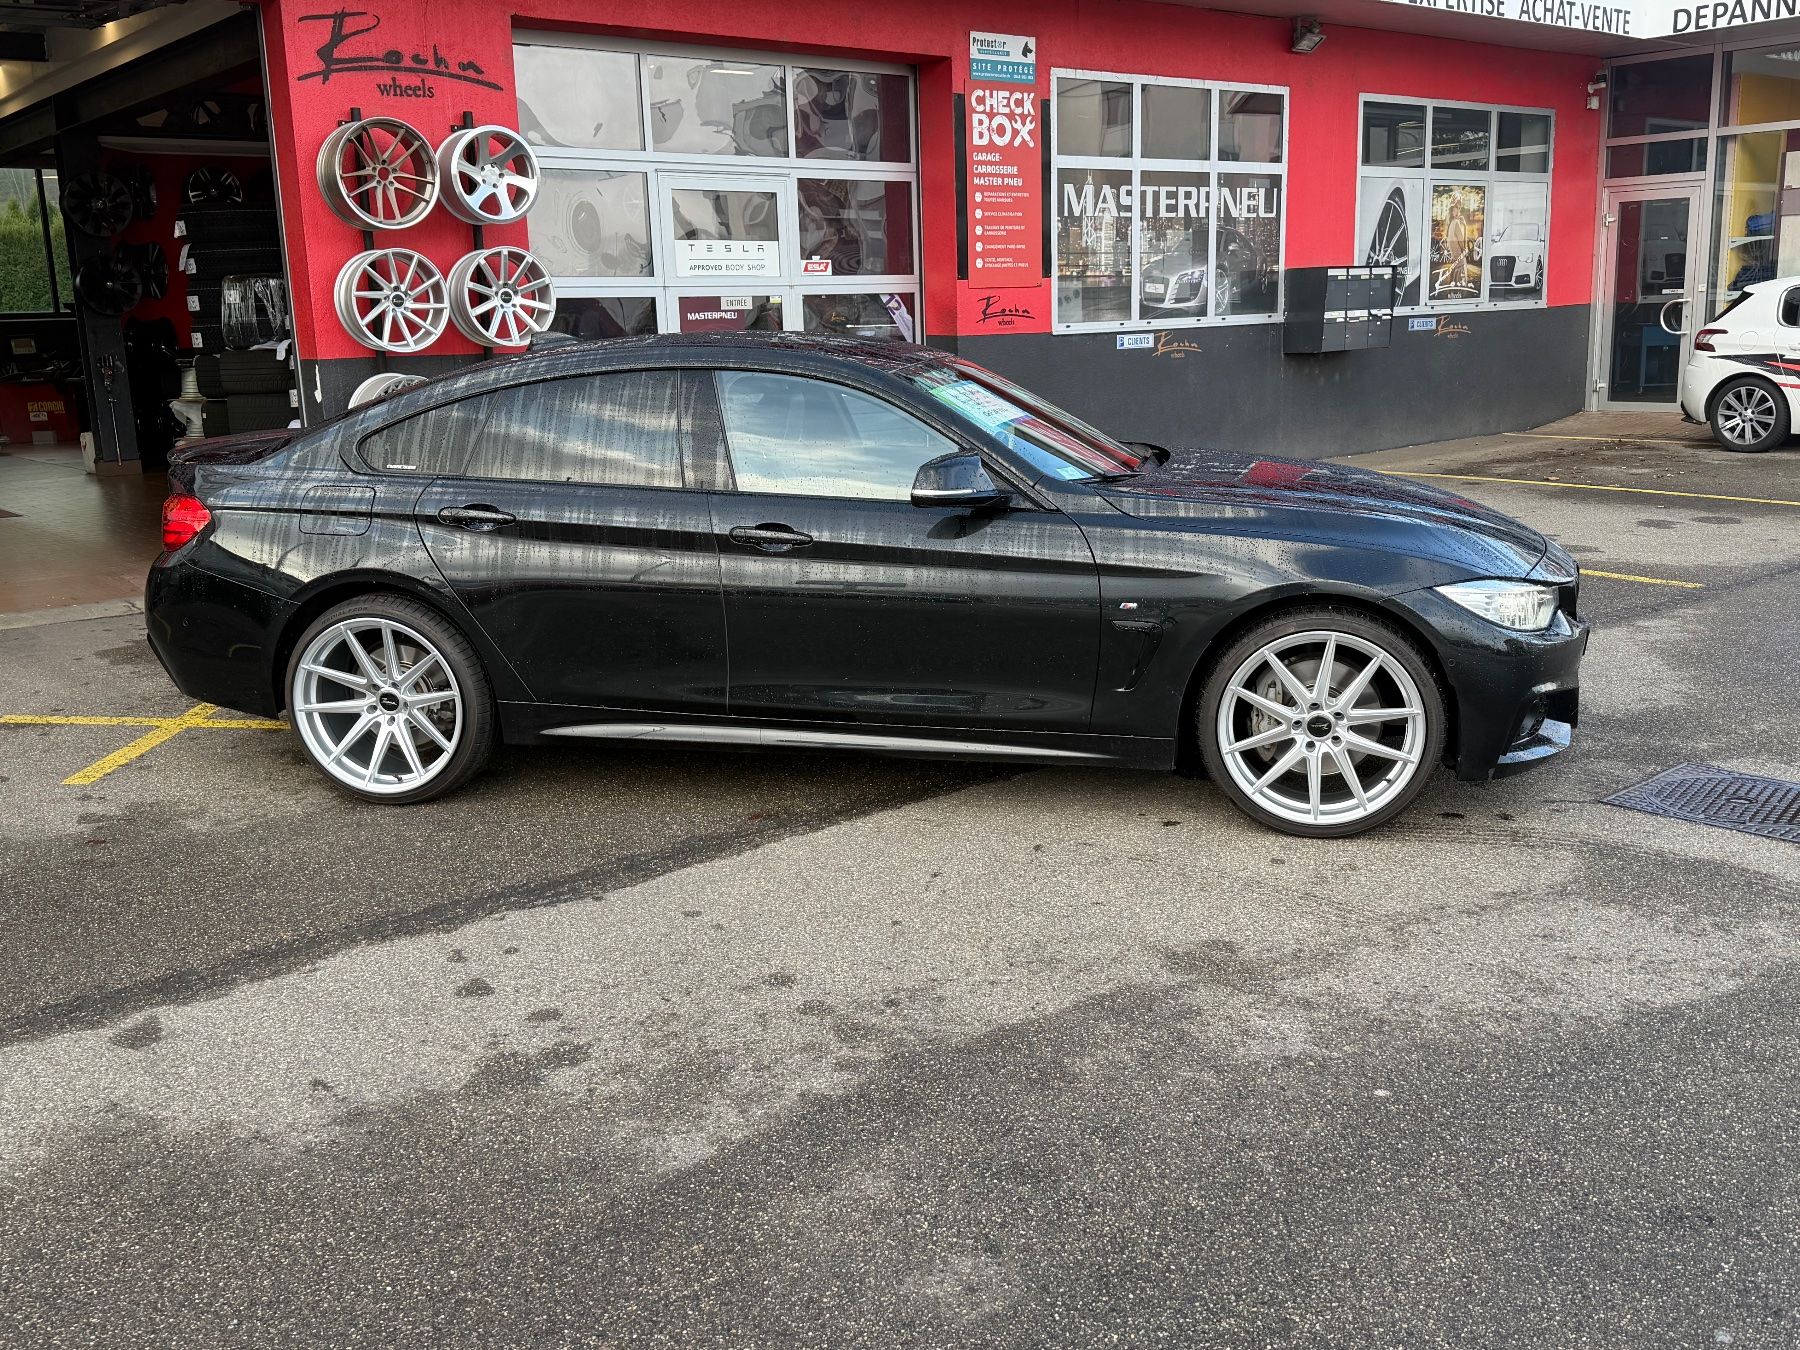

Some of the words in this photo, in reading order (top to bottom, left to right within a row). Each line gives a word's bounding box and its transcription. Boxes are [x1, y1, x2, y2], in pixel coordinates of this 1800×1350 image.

[1408, 0, 1505, 17] RTISE
[1519, 0, 1631, 35] ACHAT-VENTE
[1673, 0, 1800, 33] DEPANN
[972, 62, 992, 71] SITE
[997, 64, 1034, 74] PROTÉGÉ
[376, 76, 435, 98] wheels
[971, 89, 1036, 115] CHECK
[972, 113, 1036, 148] BOX
[973, 152, 1002, 161] GARAGE-
[973, 164, 1019, 175] CARROSSERIE
[973, 176, 1003, 186] MASTER
[1004, 177, 1023, 187] PNEU
[1063, 183, 1278, 219] MASTERPNEU
[688, 243, 765, 252] TESLA
[725, 263, 745, 271] BODY
[747, 263, 766, 271] SHOP
[726, 297, 748, 307] ENTRÉE
[687, 311, 738, 321] MASTERPNEU
[1127, 336, 1150, 346] CLIENTS
